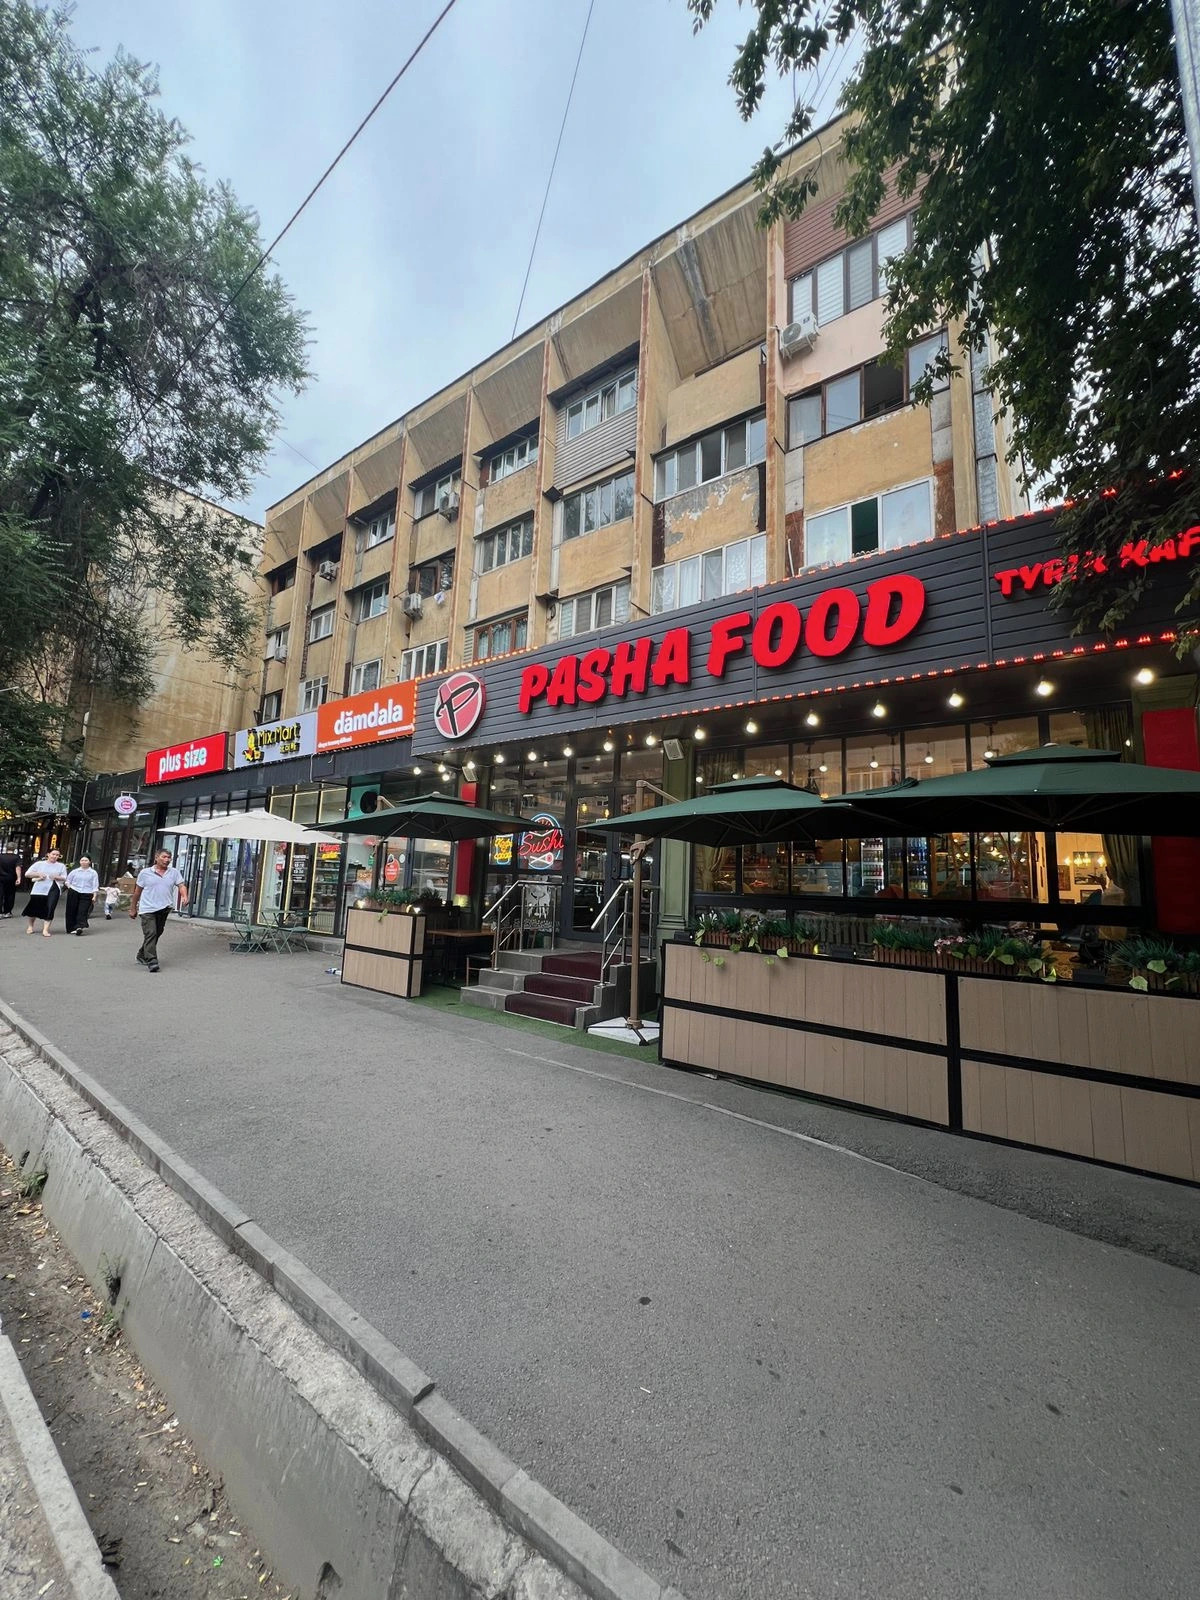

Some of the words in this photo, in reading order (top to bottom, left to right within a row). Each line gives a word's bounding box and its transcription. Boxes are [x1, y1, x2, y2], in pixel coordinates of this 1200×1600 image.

[518, 627, 690, 714] PASHA
[705, 574, 926, 678] FOOD
[158, 749, 182, 780] plus
[183, 743, 208, 768] size
[517, 828, 565, 856] Sushi
